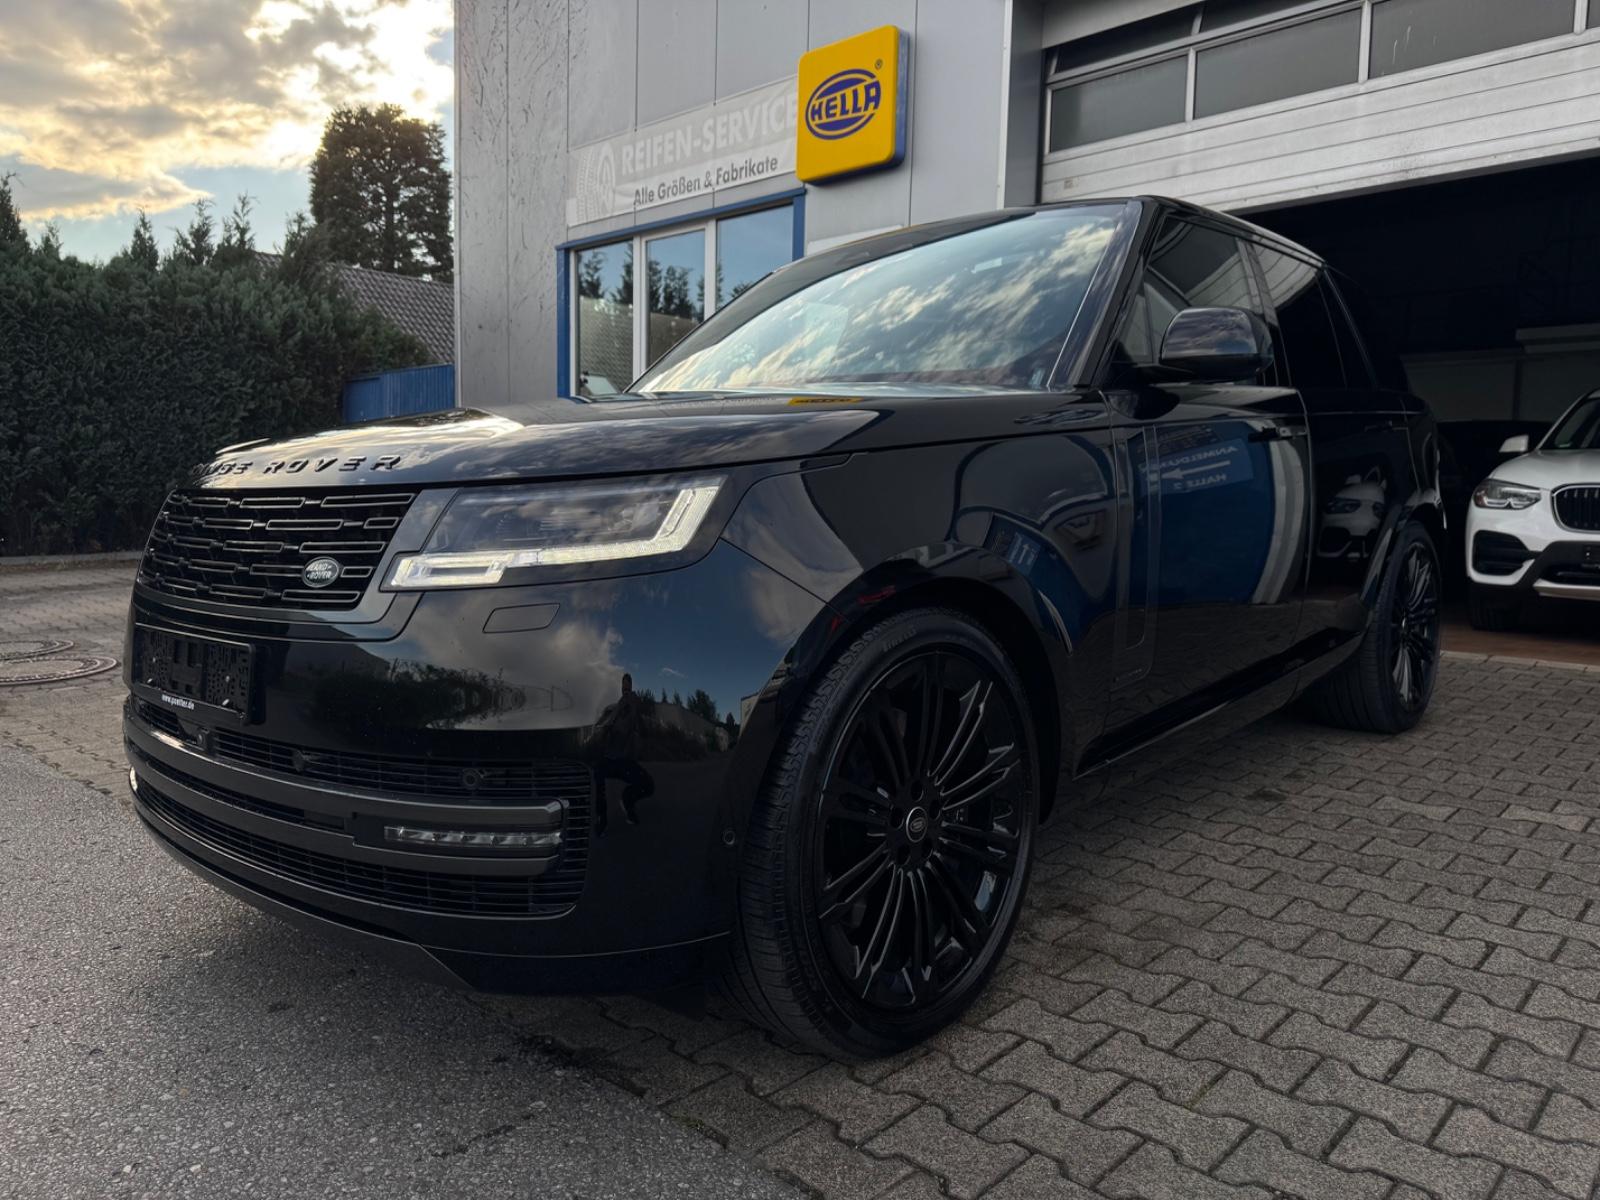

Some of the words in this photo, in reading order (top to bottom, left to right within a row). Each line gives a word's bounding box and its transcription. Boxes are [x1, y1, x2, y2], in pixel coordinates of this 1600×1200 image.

[810, 80, 881, 121] HELLA
[622, 92, 798, 174] REIFEN-SERVICE
[633, 187, 655, 206] Alle
[657, 176, 701, 201] Größen
[703, 170, 713, 188] &
[716, 156, 778, 185] Fabrikate
[263, 455, 402, 474] ROVER
